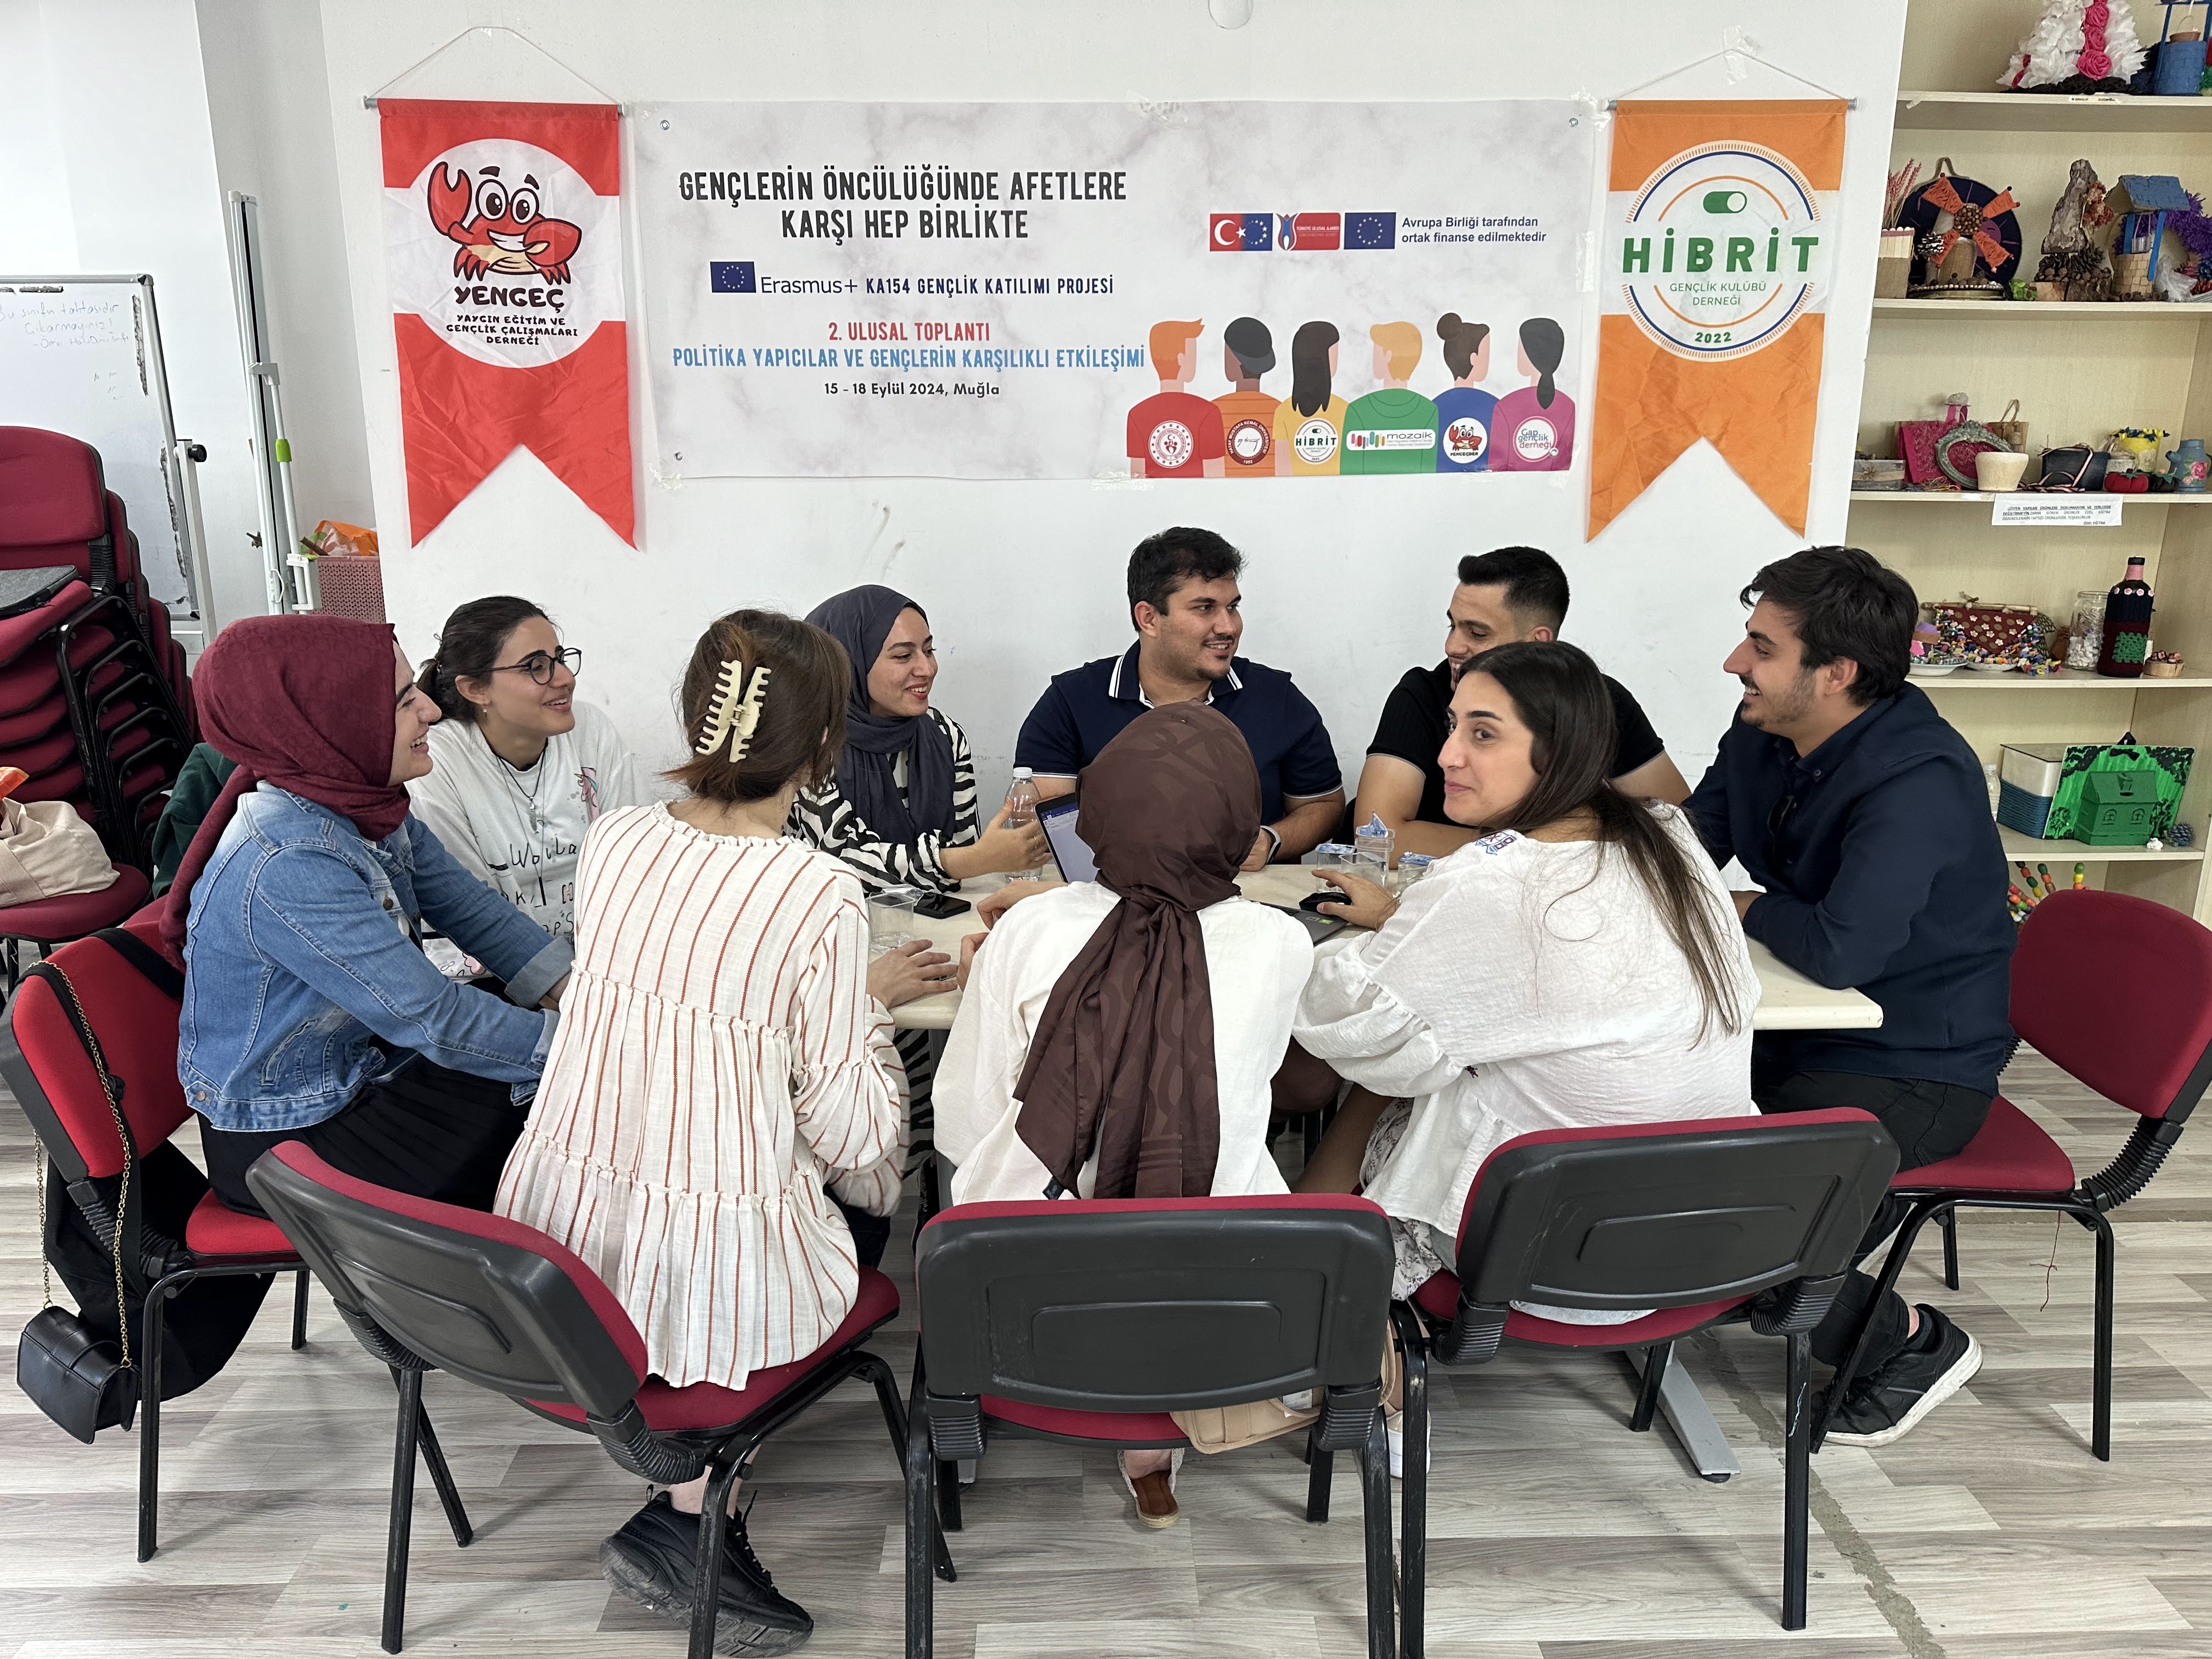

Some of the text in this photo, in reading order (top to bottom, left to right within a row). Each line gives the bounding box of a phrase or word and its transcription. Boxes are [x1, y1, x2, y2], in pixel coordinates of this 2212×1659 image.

[679, 163, 1126, 207] GENÇLERİN ÖNCÜLÜĞÜNDE AFETLERE
[782, 204, 1028, 246] KARŞI HEP BİRLİKTE
[1402, 217, 1538, 230] Avrupa Birliği tarafından
[1402, 232, 1547, 242] ortak finanse edilmektedir
[1622, 227, 1819, 273] HİBRİT
[761, 274, 1113, 298] Erasmus+ KA154 GENÇLİK KATILIMI PROJESİ
[1670, 280, 1766, 294] GENÇLİK KULÜBÜ
[454, 286, 565, 313] YENGEÇ
[1692, 295, 1740, 306] DERNEĞİ
[456, 314, 566, 326] YAYGIN EĞİTİM VE
[446, 323, 578, 337] GENÇLİK ÇALIŞMALARI
[828, 321, 990, 341] 2. ULUSAL TOPLANTI
[1695, 331, 1733, 343] 2022
[486, 333, 539, 345] DERNEĞİ
[673, 344, 1144, 373] POLİTİKA YAPICILAR VE GENÇLERİN KARŞILIKLI ETKİLEŞİMİ
[825, 383, 838, 394] 15
[853, 382, 866, 394] 18
[871, 382, 904, 398] Eylül
[910, 383, 949, 397] 2024,
[953, 382, 1000, 398] Muğla
[1518, 434, 1548, 443] gençlik
[1521, 428, 1538, 438] Gap
[1295, 435, 1337, 446] HİBRİT
